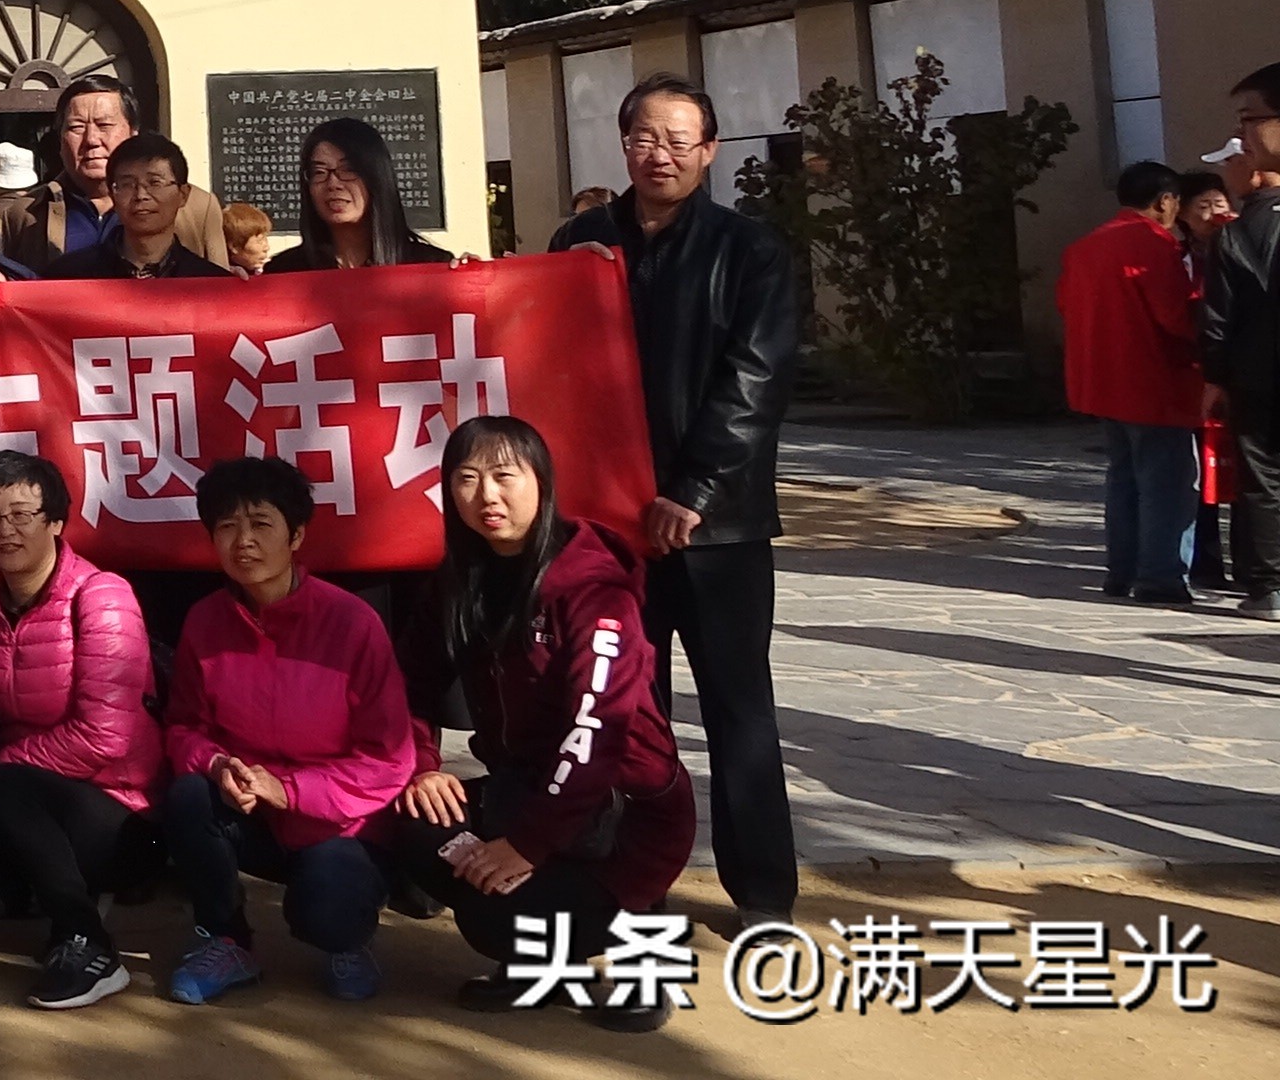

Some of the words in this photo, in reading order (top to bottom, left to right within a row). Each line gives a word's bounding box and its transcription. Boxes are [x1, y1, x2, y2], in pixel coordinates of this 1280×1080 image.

[228, 87, 416, 105] 中国共产党七届二中全会旧址
